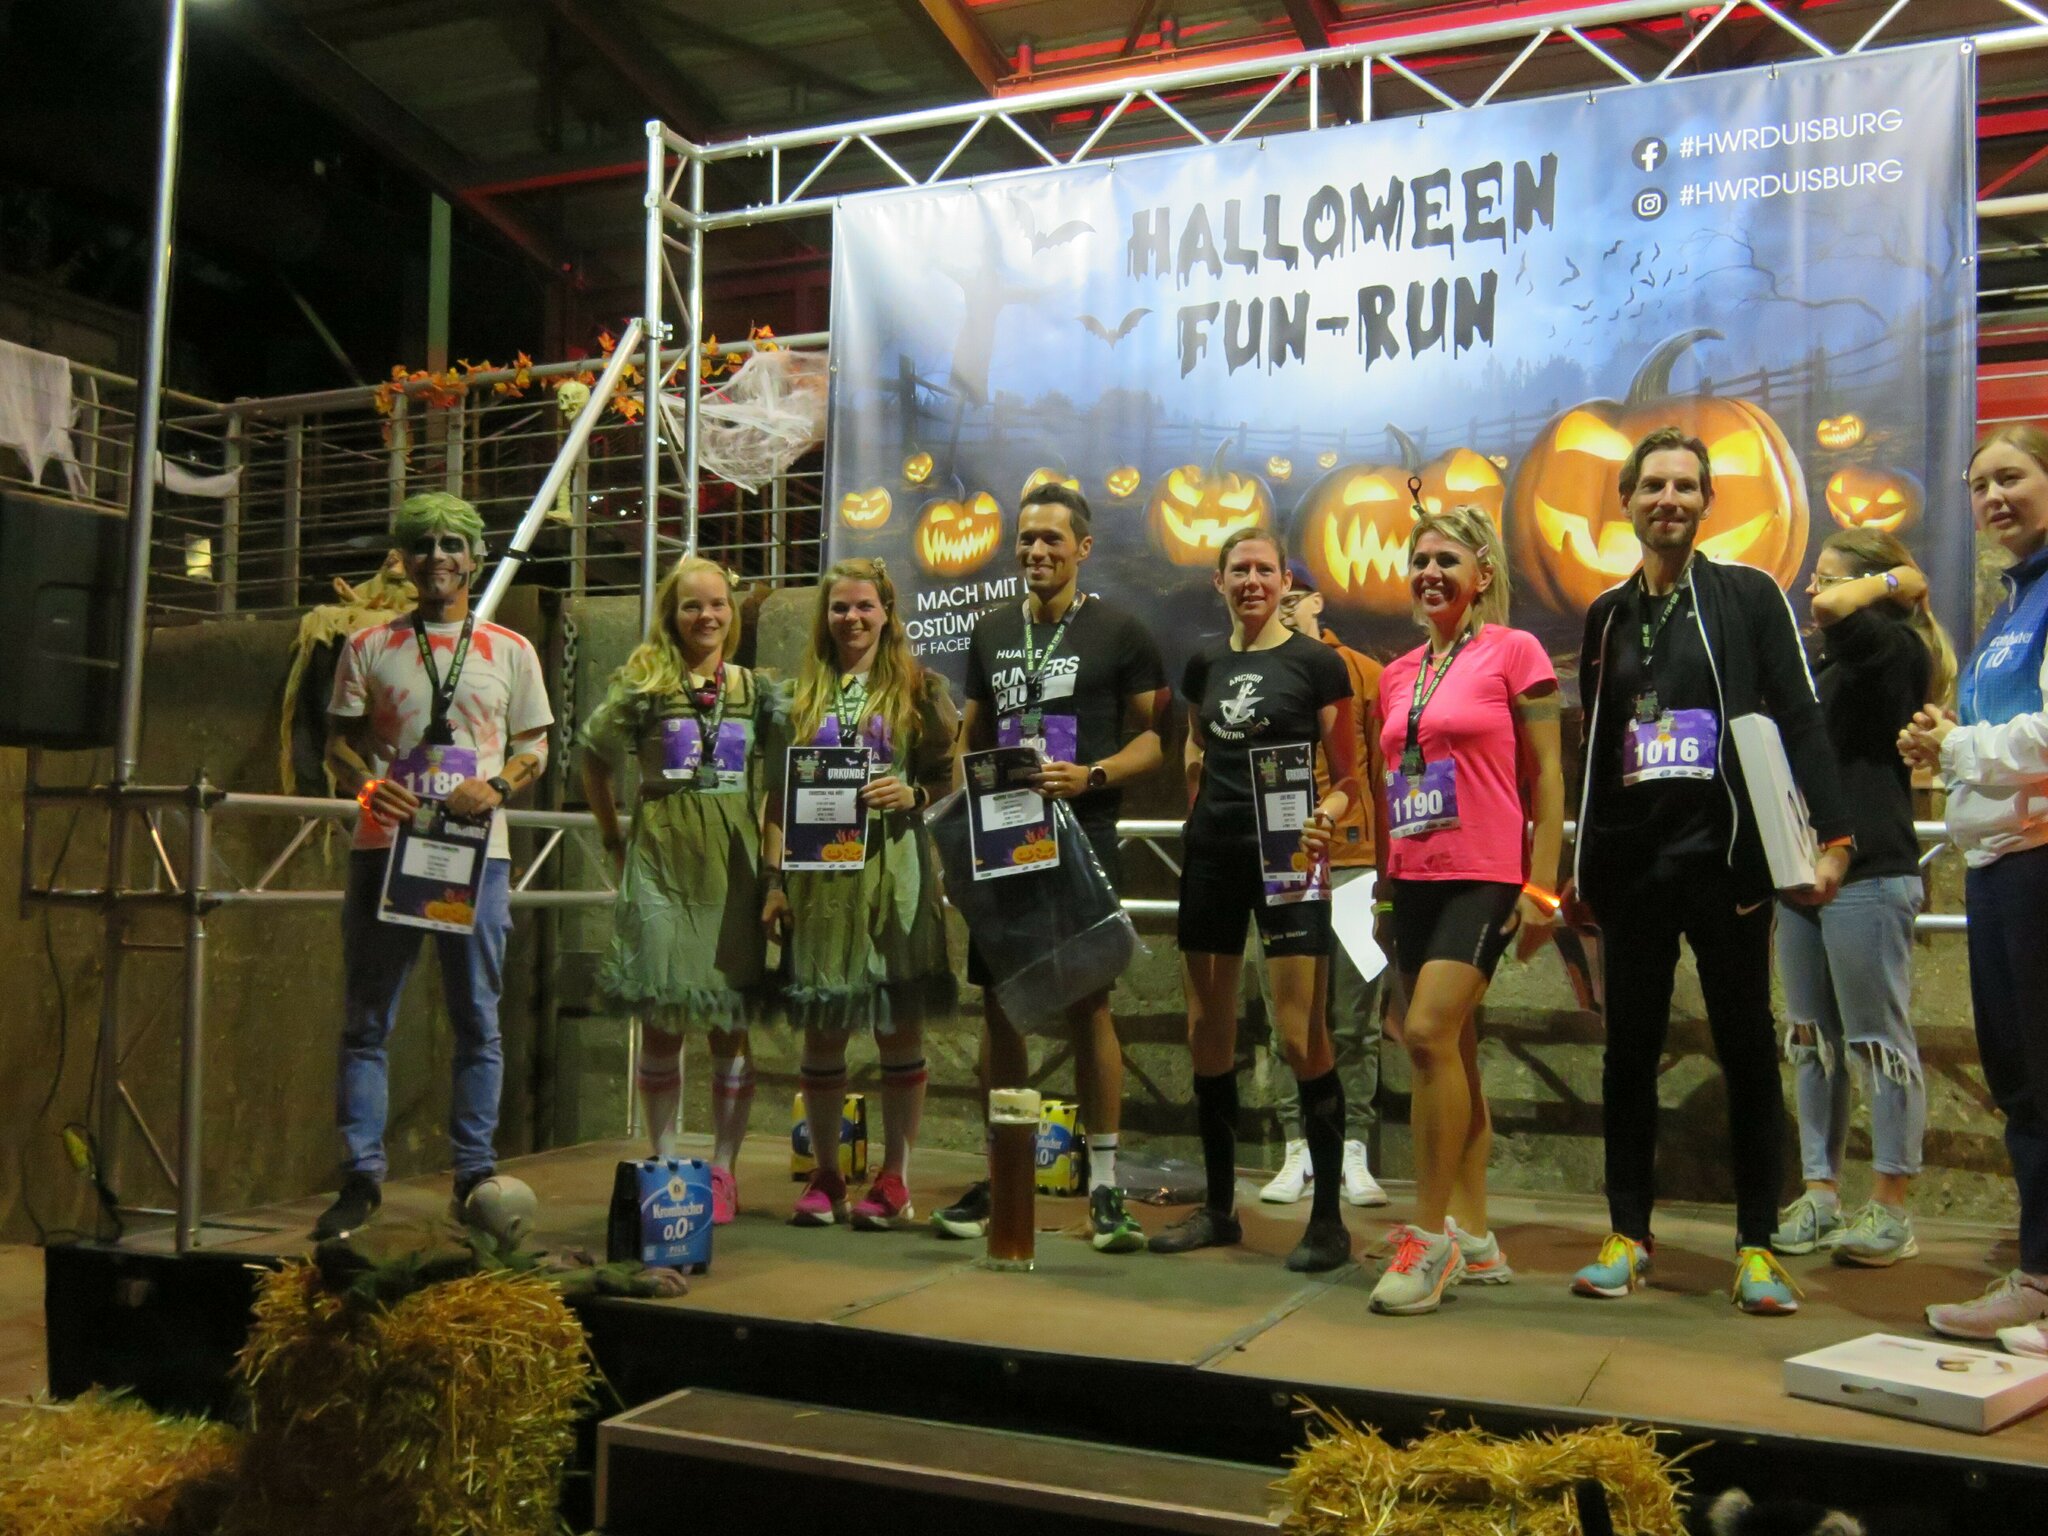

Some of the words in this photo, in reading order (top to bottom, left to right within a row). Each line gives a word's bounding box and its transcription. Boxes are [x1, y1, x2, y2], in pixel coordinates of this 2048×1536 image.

[1679, 108, 1904, 159] #HWRDUISBURG
[1679, 158, 1904, 207] #HWRDUISBURG
[1126, 151, 1559, 292] HALLOWEEN
[1176, 268, 1498, 380] FUN-RUN
[917, 584, 979, 612] MACH
[985, 577, 1018, 600] MIT
[902, 611, 986, 640] OSTÜM
[910, 642, 927, 657] UF
[992, 656, 1080, 694] RUNERS
[1229, 673, 1264, 687] ANCHOR
[1209, 720, 1246, 740] RUNNING
[1634, 737, 1699, 767] 1016
[827, 768, 866, 780] URKUNDE
[1393, 789, 1444, 823] 1190
[652, 1202, 704, 1219] Krombacher
